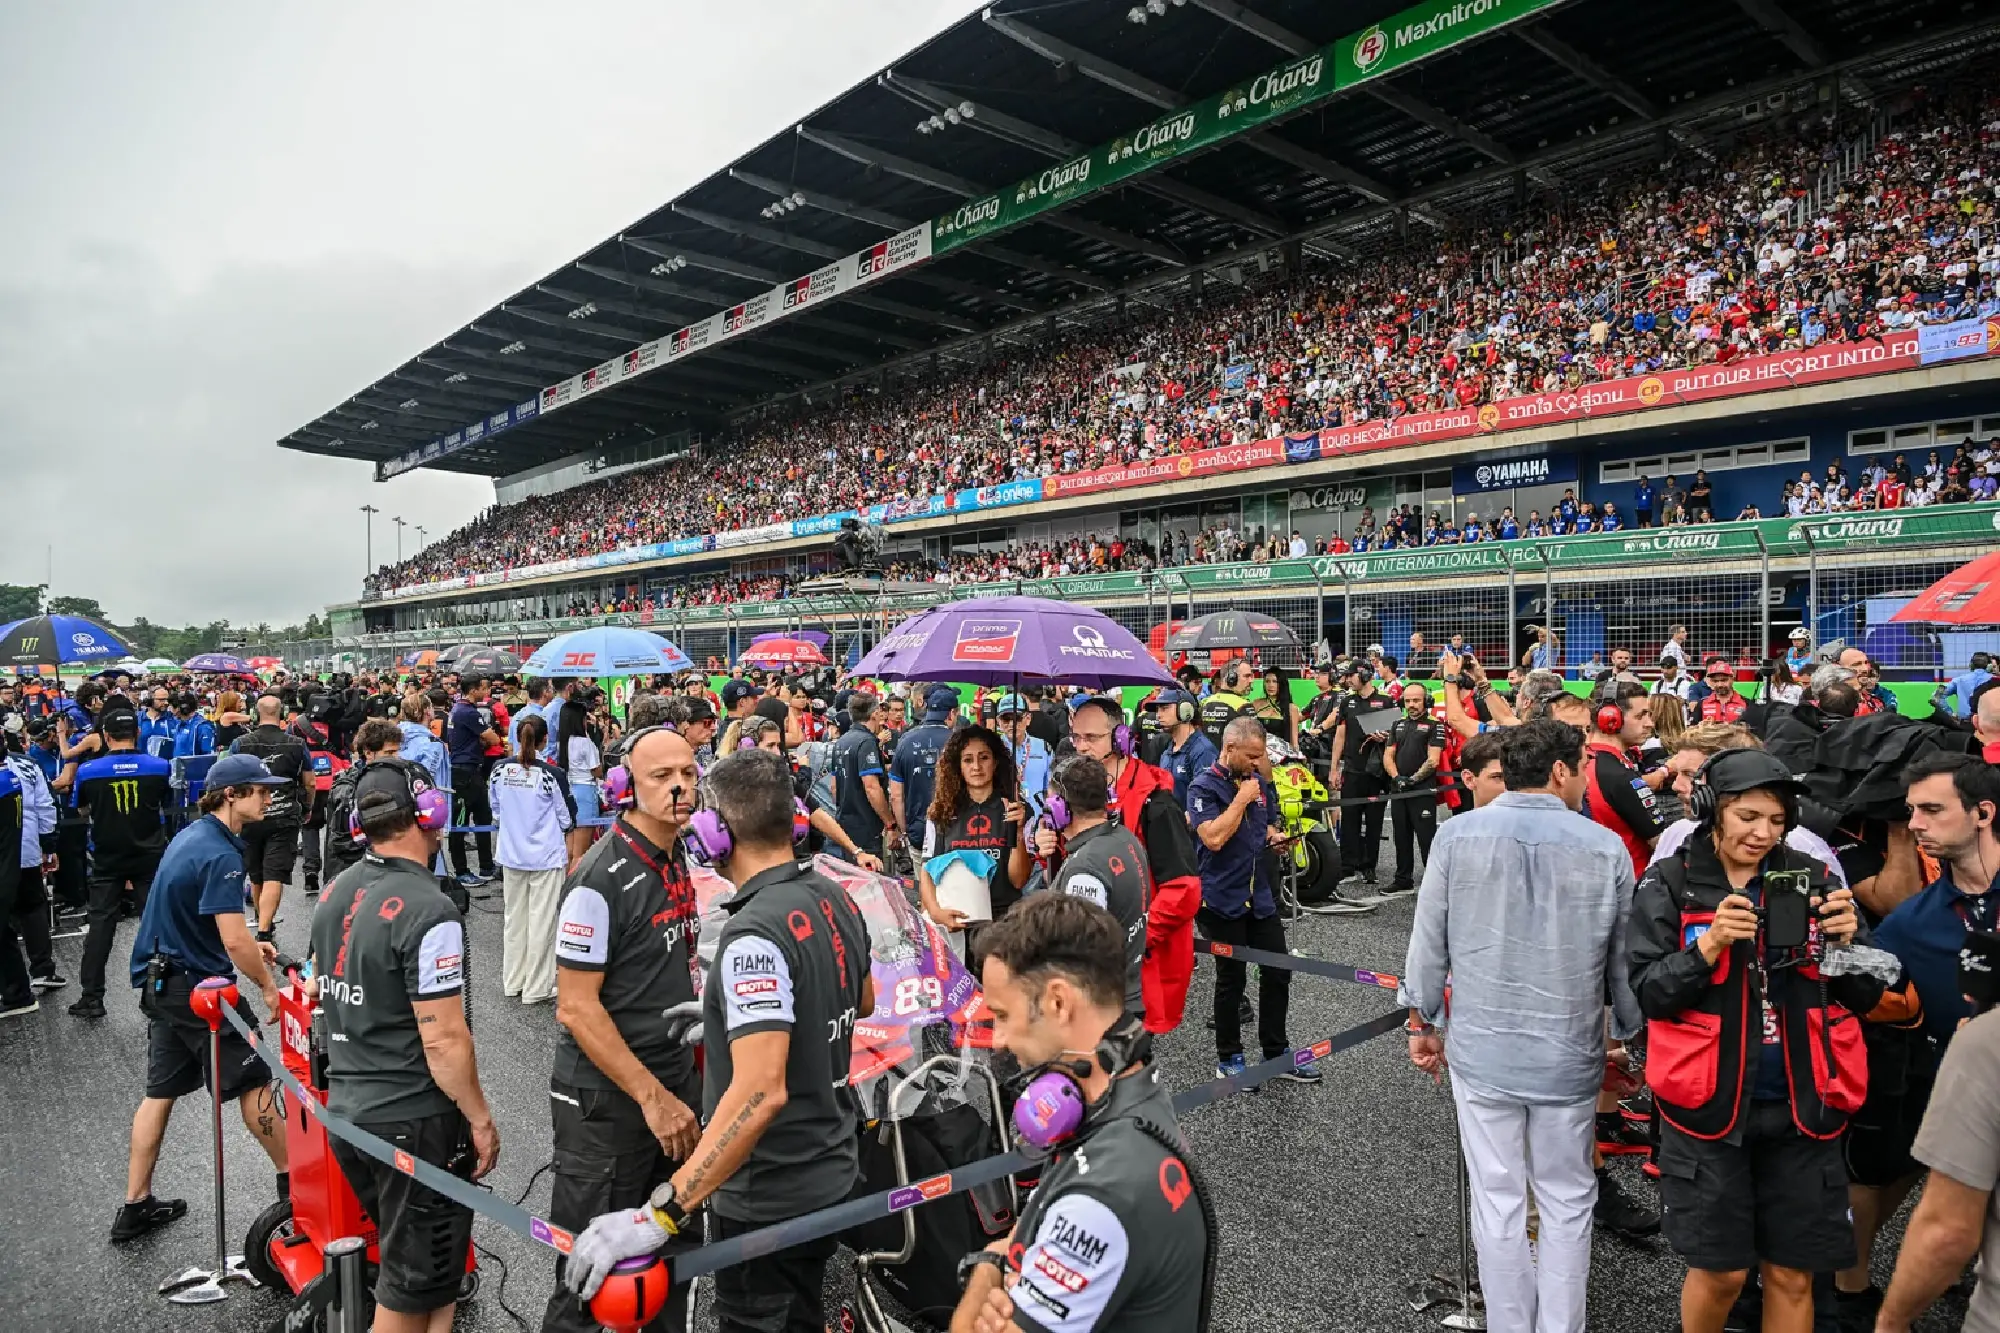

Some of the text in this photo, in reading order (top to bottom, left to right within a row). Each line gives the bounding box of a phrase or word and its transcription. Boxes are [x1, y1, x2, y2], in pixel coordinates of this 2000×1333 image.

[1395, 0, 1501, 49] Maxnitron
[1250, 57, 1323, 104] Chang
[1134, 115, 1195, 153] Chang
[1039, 159, 1091, 194] Chang
[955, 198, 1000, 229] Chang
[858, 254, 885, 280] GR
[783, 288, 809, 310] GR
[723, 317, 744, 335] GR
[669, 339, 689, 357] GR
[1675, 374, 1710, 392] PUT
[1714, 368, 1750, 386] OUR
[1838, 345, 1886, 367] INTO
[1891, 340, 1919, 361] FO
[1642, 385, 1660, 396] CP
[1327, 435, 1350, 448] OUR
[1403, 422, 1432, 435] INTO
[1435, 415, 1471, 430] FOOD
[1128, 467, 1147, 479] INTO
[1150, 463, 1173, 475] FOOD
[1492, 458, 1549, 480] YAMAHA
[1311, 488, 1366, 507] Chang
[1822, 517, 1904, 539] Chang
[1654, 531, 1720, 549] Chang
[1314, 545, 1565, 578] Chang INTERNATIONAL CIRCUIT
[1231, 567, 1271, 580] Chang
[1060, 645, 1135, 660] PRAMAC
[951, 836, 1009, 848] PRAMAC
[1072, 885, 1098, 898] FIAMM
[733, 954, 776, 973] FIAMM
[317, 974, 364, 1006] prma
[736, 980, 777, 995] MOTUL
[895, 976, 944, 1015] 89
[828, 1006, 856, 1042] prim
[854, 1026, 888, 1039] OTUL
[1051, 1215, 1110, 1265] FIAMM
[1036, 1253, 1084, 1291] MOTUL
